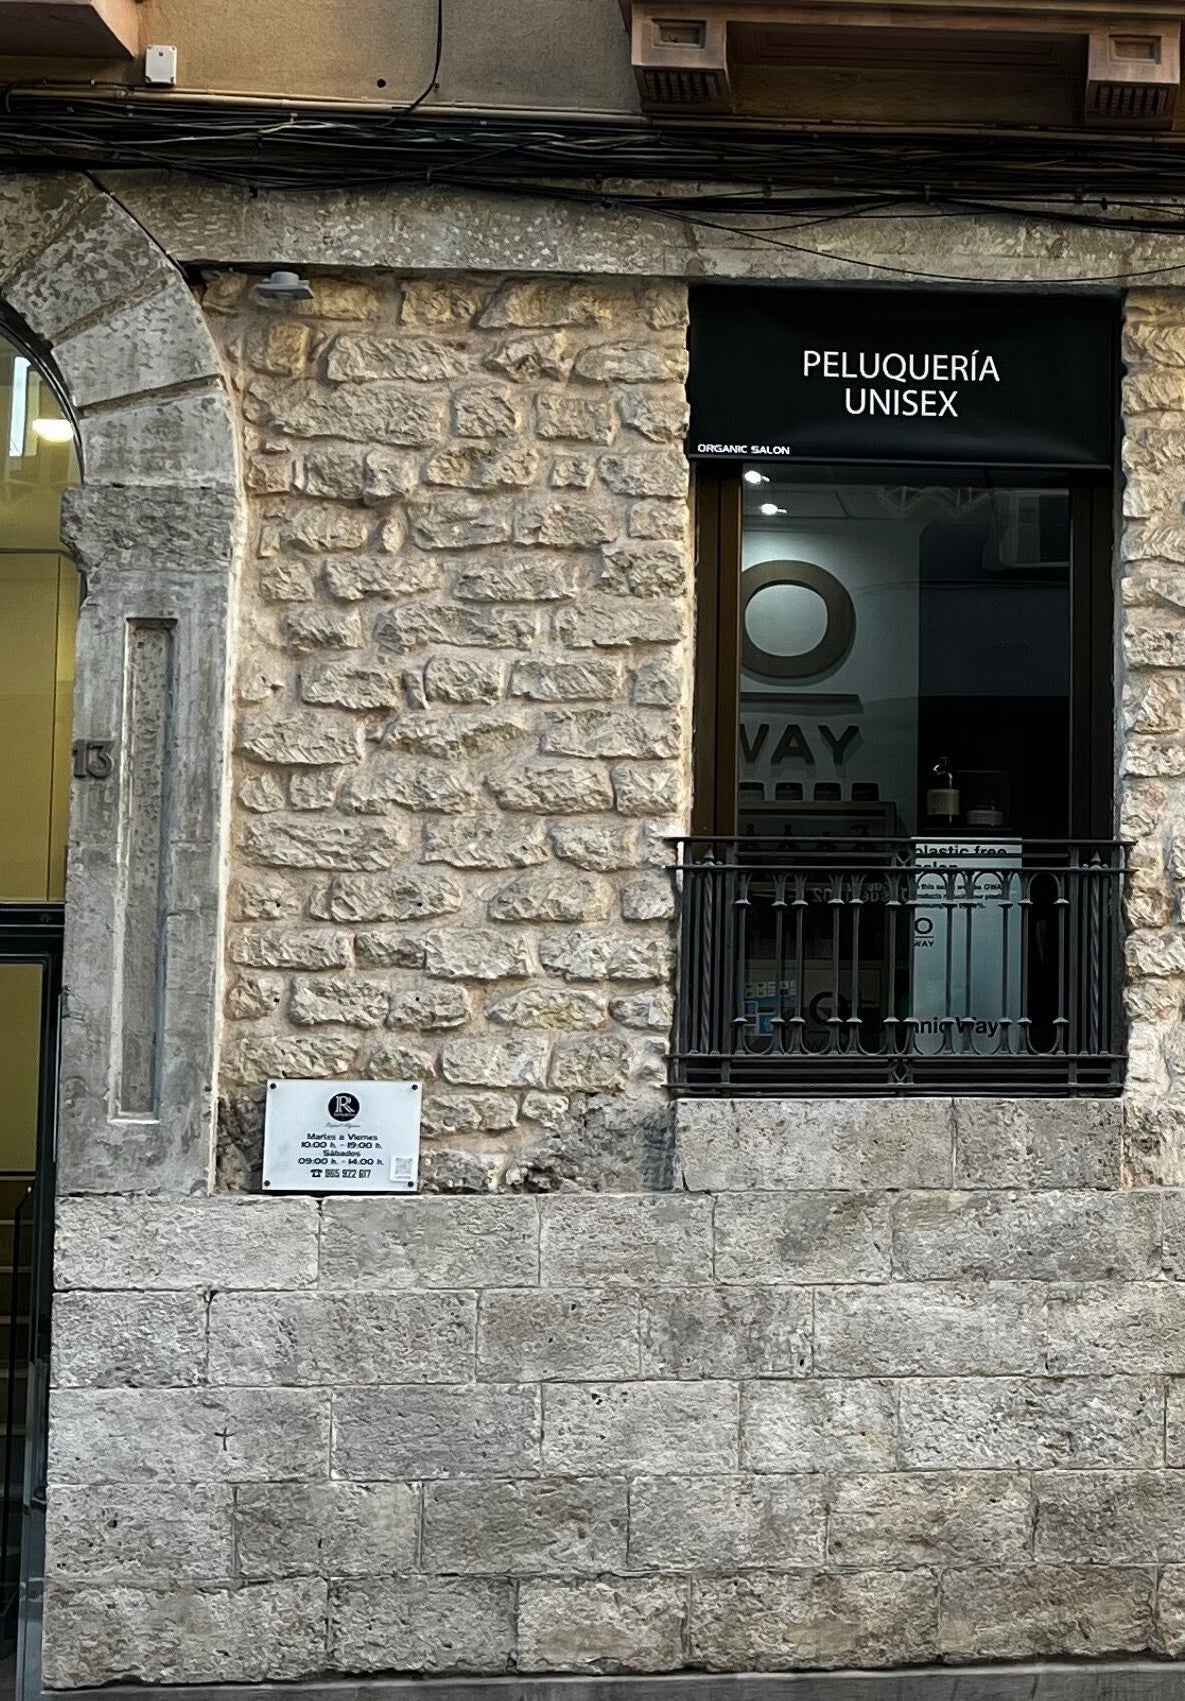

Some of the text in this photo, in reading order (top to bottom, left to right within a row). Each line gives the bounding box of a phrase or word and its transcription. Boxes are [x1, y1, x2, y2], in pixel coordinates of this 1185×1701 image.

[803, 349, 1000, 383] PELUQUERÍA
[845, 388, 959, 417] UNISEX
[697, 443, 790, 455] ORGANIC SALON
[73, 739, 114, 780] 13
[323, 1149, 361, 1157] Sábados
